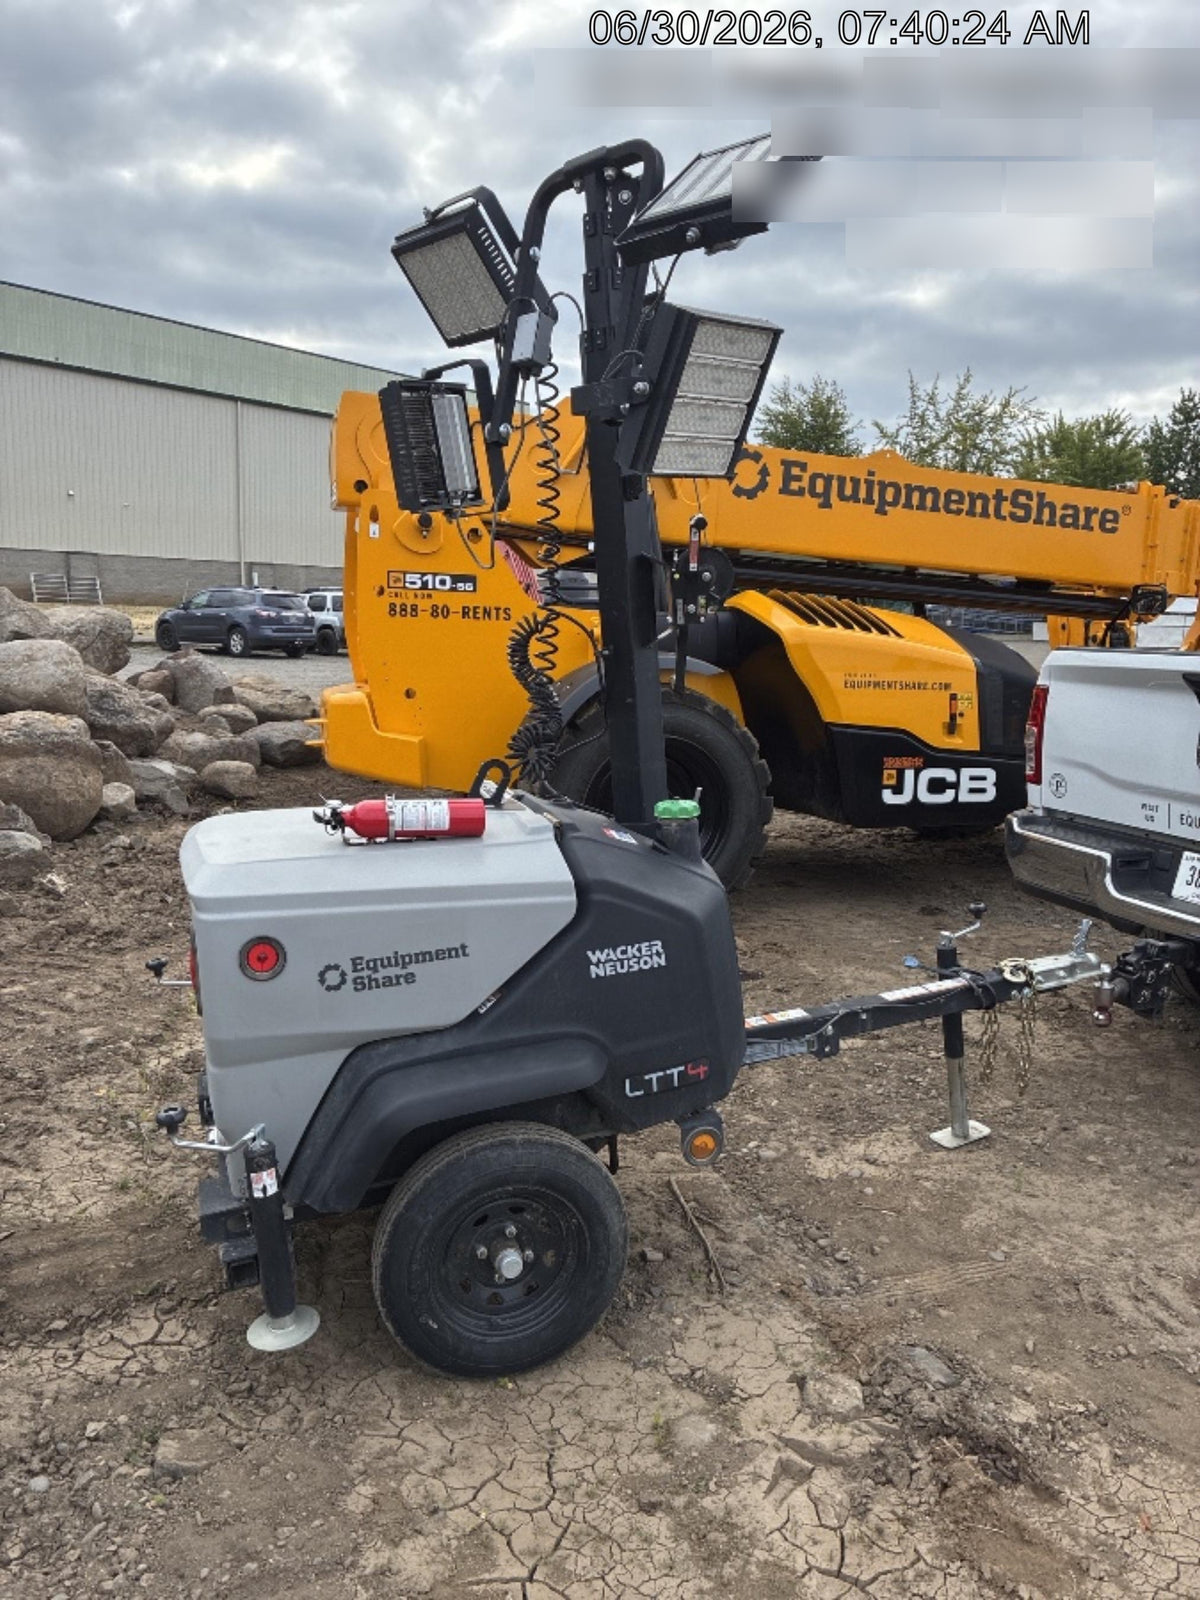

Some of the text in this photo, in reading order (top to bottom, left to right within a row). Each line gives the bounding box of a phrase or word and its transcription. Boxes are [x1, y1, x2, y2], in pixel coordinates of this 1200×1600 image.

[388, 602, 512, 620] 888-80-RENTS
[881, 767, 997, 804] JCB
[350, 942, 470, 973] Equipment
[586, 939, 665, 964] WACKER
[589, 953, 668, 979] NEUSON
[352, 968, 417, 992] Share
